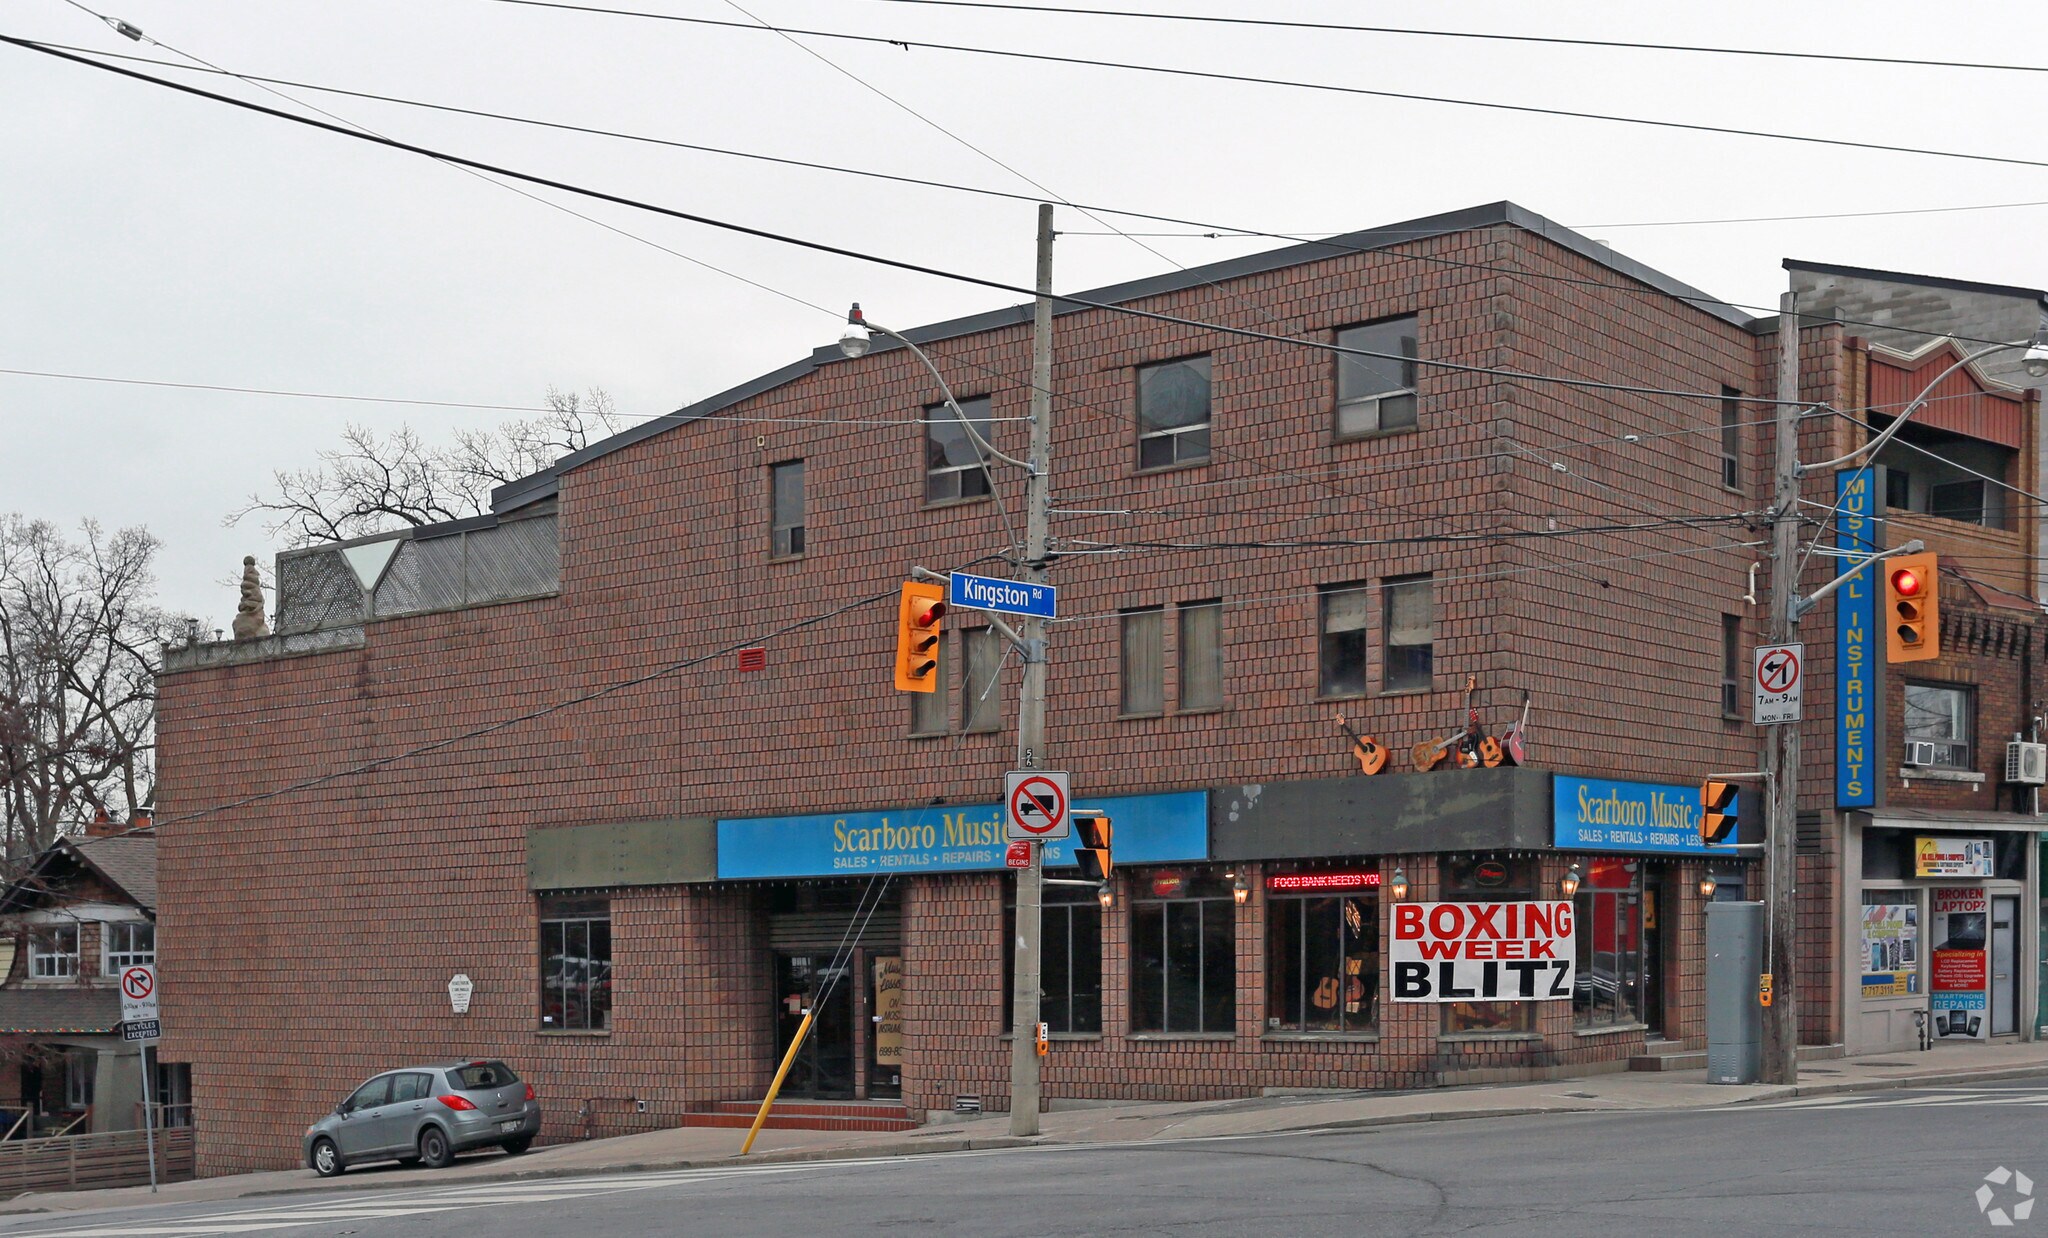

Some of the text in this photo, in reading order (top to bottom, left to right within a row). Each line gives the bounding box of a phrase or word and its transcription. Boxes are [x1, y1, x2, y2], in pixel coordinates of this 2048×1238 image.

[1846, 479, 1865, 599] MUSICAL
[964, 578, 1042, 608] Kingston Rd
[1758, 695, 1774, 705] 7AM
[1782, 693, 1798, 703] 9AM
[1845, 612, 1865, 797] INSTRUMENTS
[1577, 785, 1692, 829] Scarboro Music
[833, 817, 935, 853] Scarboro
[1578, 829, 1602, 842] SALES
[1610, 831, 1643, 844] RENTALS
[1650, 833, 1679, 846] REPAIRS
[833, 850, 991, 869] SALES RENTALS REPAIRS
[1274, 877, 1300, 888] FOOD
[1301, 876, 1327, 887] BANK
[1328, 874, 1361, 886] NEEDS
[1937, 888, 1984, 900] BROKEN
[1934, 900, 1986, 912] LAPTOP?
[1395, 902, 1572, 940] BOXING
[1417, 940, 1556, 960] WEEK
[1936, 951, 1976, 959] Specializing
[880, 978, 901, 993] Lesso
[1395, 960, 1570, 998] BLITZ
[1934, 1000, 1984, 1009] REPAIRS
[127, 1021, 156, 1032] BICYCLES
[127, 1029, 158, 1040] EXCEPTED
